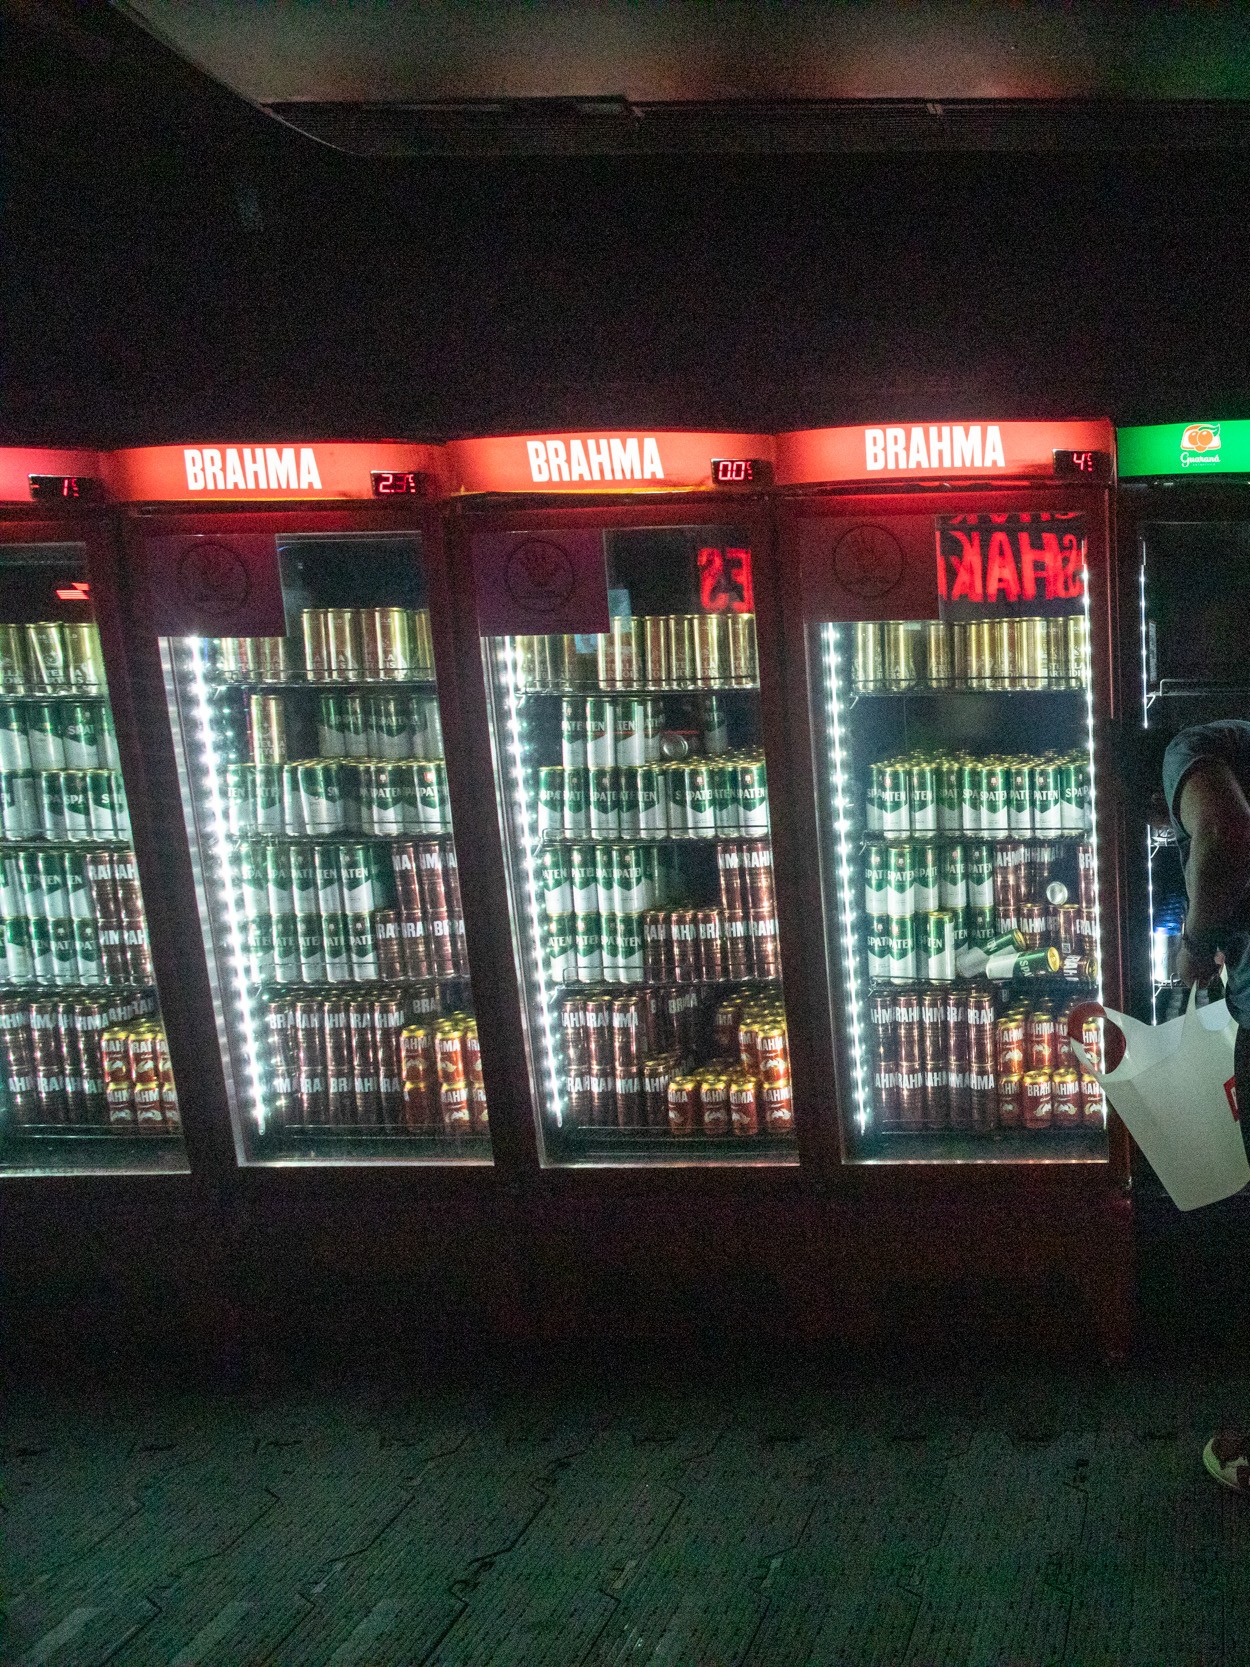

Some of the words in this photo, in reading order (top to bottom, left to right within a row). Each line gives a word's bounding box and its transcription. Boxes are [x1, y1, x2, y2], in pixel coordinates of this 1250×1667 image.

[184, 448, 322, 490] BRAHMA
[526, 438, 664, 482] BRAHMA
[865, 425, 1006, 470] BRAHMA
[1180, 452, 1221, 467] Guaraná
